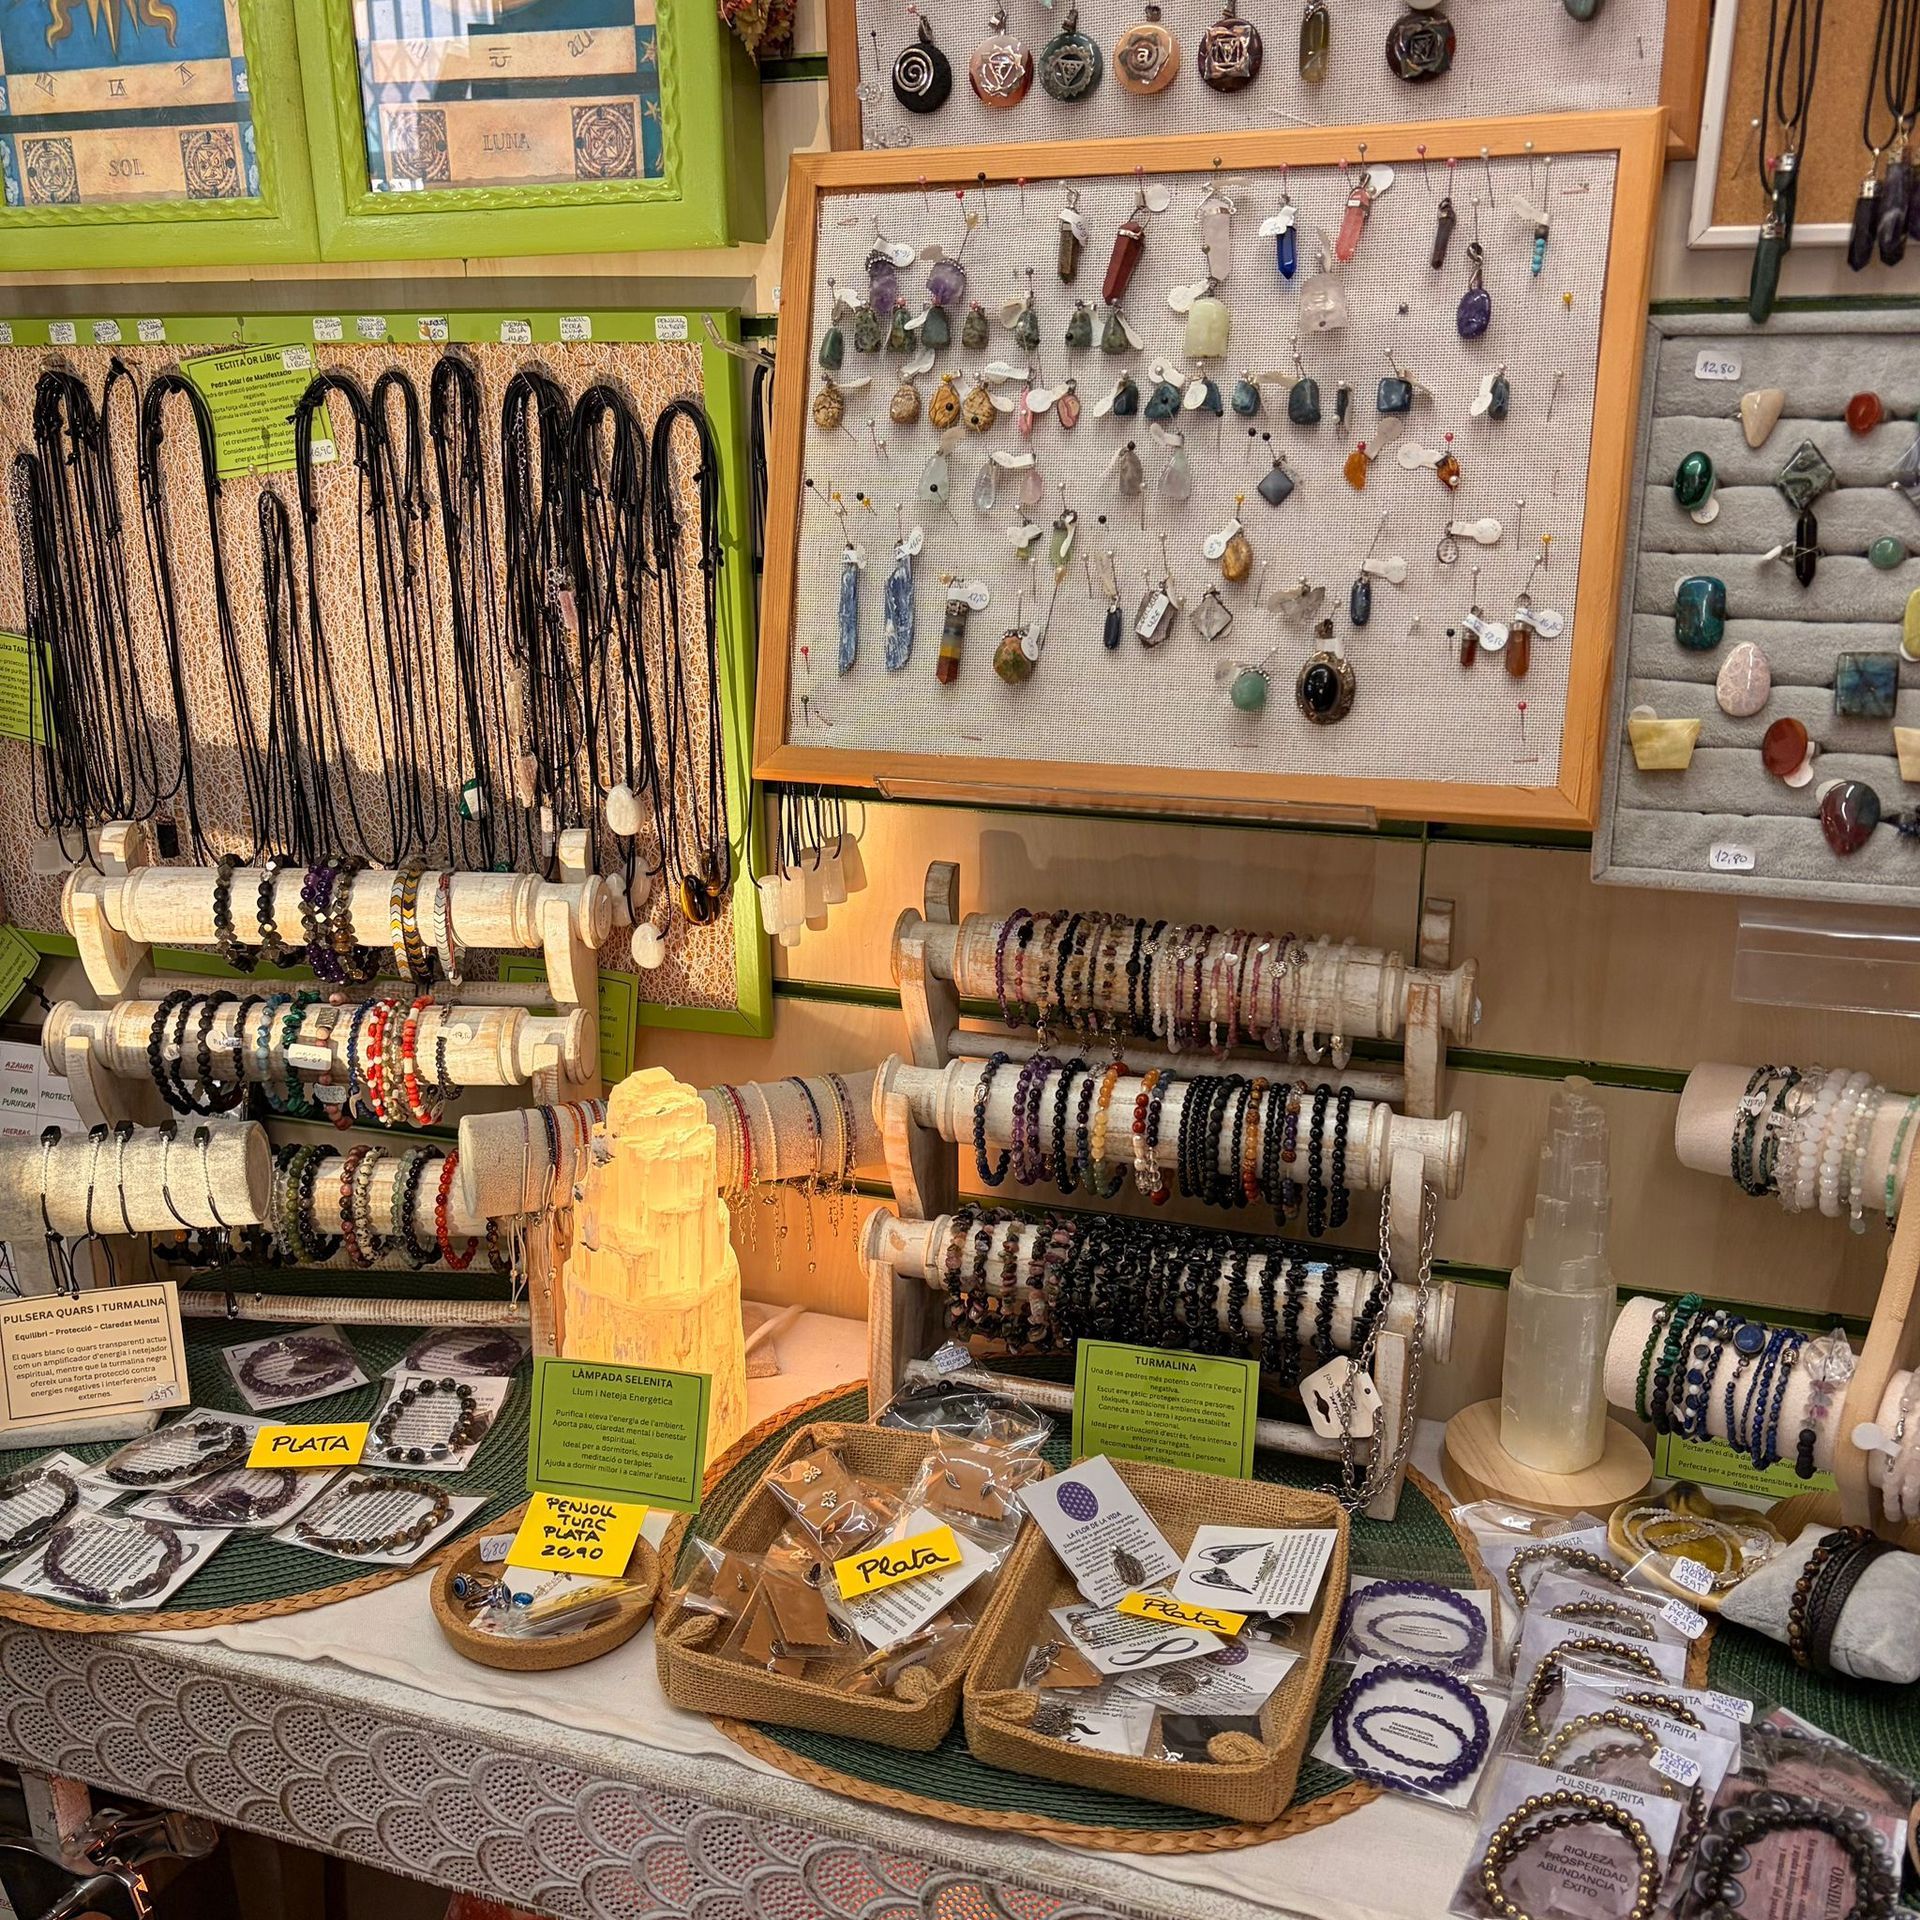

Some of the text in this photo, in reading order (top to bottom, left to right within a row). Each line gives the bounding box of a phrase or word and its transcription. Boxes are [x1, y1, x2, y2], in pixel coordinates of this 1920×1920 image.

[482, 134, 530, 151] LUNA
[109, 159, 145, 177] SOL
[214, 352, 281, 371] TECTITA OR LÍBIC
[10, 1087, 28, 1095] PARA
[1, 1098, 36, 1109] PURIFICAR
[3, 1298, 165, 1324] PULSERA QUARS TURMALINA
[15, 1317, 159, 1342] Equilibri Protecció Claredat Mental
[21, 1352, 42, 1361] quars
[76, 1346, 97, 1354] quars
[99, 1338, 144, 1349] transparent)
[147, 1336, 166, 1344] actua
[44, 1355, 90, 1367] amplificador
[132, 1346, 167, 1355] netejador
[17, 1369, 54, 1380] espiritual,
[57, 1366, 83, 1374] mentre
[85, 1364, 99, 1372] que
[109, 1358, 144, 1367] turmalina
[1135, 1357, 1197, 1372] TURMALINA
[30, 1378, 56, 1387] ofereix
[95, 1368, 129, 1380] protecció
[132, 1366, 155, 1374] contra
[572, 1369, 673, 1387] LÀMPADA SELENITA
[1125, 1372, 1147, 1380] pedres
[31, 1376, 156, 1396] energies negatives interferències
[1150, 1385, 1180, 1393] negativa.
[78, 1392, 112, 1400] externes.
[572, 1388, 673, 1405] Llum Neteja Energètica
[1150, 1394, 1180, 1402] protegeix
[1205, 1401, 1235, 1409] persones
[556, 1409, 583, 1418] Purifica
[589, 1413, 607, 1421] eleva
[1098, 1404, 1129, 1413] Connecta
[1198, 1417, 1230, 1426] estabilitat
[1101, 1396, 1225, 1417] tòxiques, radiacions ambients densos.
[553, 1419, 577, 1428] Aporta
[596, 1424, 624, 1433] claredat
[656, 1431, 686, 1440] benestar
[1091, 1420, 1107, 1428] Ideal
[1126, 1426, 1159, 1435] situacions
[1190, 1434, 1206, 1442] feina
[1208, 1437, 1231, 1445] intensa
[1145, 1421, 1180, 1429] emocional.
[272, 1436, 350, 1452] PLATA
[602, 1436, 636, 1444] espiritual.
[1132, 1435, 1191, 1448] entorns carregats.
[563, 1441, 580, 1449] Ideal
[602, 1446, 639, 1457] dormitoris,
[1100, 1438, 1225, 1462] Recomanada terapeutes persones
[545, 1459, 565, 1467] Ajuda
[573, 1463, 596, 1471] dormir
[598, 1466, 617, 1474] millor
[582, 1454, 652, 1467] meditació teràpies.
[1678, 1461, 1792, 1485] Perfecta persones sensibles
[1733, 1480, 1769, 1492] dels altres
[546, 1498, 617, 1519] PENJOLL
[557, 1514, 607, 1531] TURC
[1075, 1526, 1090, 1537] FLOR
[1090, 1522, 1099, 1530] DE
[1099, 1517, 1107, 1525] LA
[1107, 1511, 1122, 1521] VIDA
[543, 1525, 600, 1542] PLATA
[1556, 1536, 1583, 1548] PIRITA
[482, 1537, 508, 1560] 6,80
[541, 1545, 604, 1559] 20,90
[857, 1548, 949, 1583] Plata
[1143, 1599, 1227, 1630] Plata
[1129, 1635, 1168, 1647] INFINITO
[1228, 1672, 1246, 1682] VIDA
[1414, 1688, 1444, 1700] AMATISTA
[1613, 1706, 1697, 1741] PULSERA PIRITA
[1556, 1775, 1645, 1806] PULSERA PIRITA
[1536, 1861, 1628, 1896] ABUNDANCIA Y
